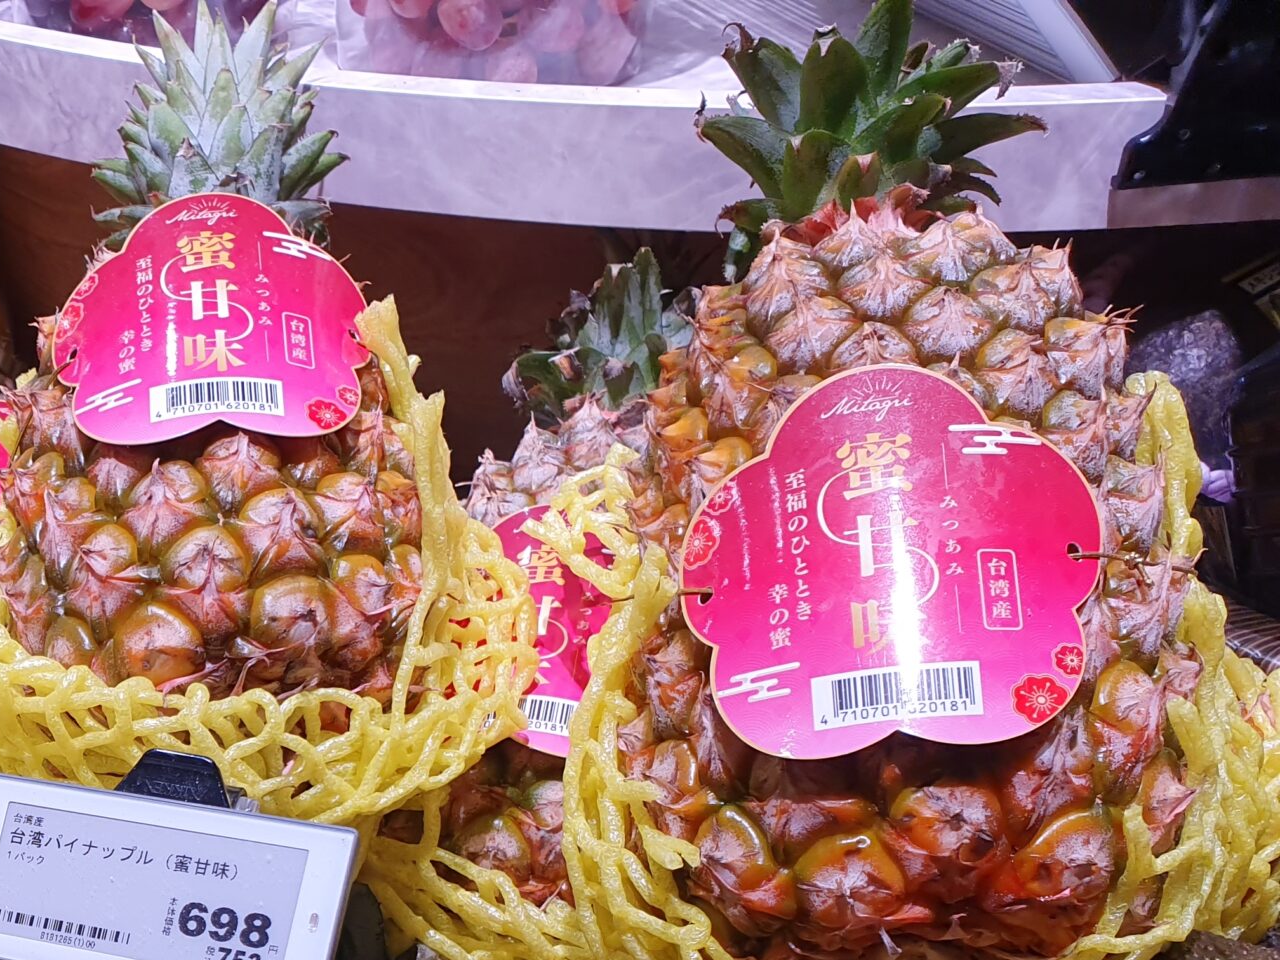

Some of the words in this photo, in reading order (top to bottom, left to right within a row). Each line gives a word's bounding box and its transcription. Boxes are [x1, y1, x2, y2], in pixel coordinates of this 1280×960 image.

[134, 255, 155, 352] 至福のひととき
[176, 230, 248, 374] 蜜甘味
[254, 273, 274, 327] みつあみ
[116, 328, 137, 375] 幸の蜜
[288, 318, 310, 363] 台湾産
[171, 402, 219, 415] 710701
[226, 401, 273, 412] 620181
[783, 468, 814, 622] 至福のひととき
[938, 494, 965, 577] みつあみ
[987, 556, 1013, 621] 台湾産
[767, 583, 793, 649] 幸の蜜
[524, 718, 565, 733] 20181
[820, 715, 828, 725] 4
[840, 705, 899, 722] 710701
[13, 813, 45, 827] 台湾産
[178, 902, 272, 949] 698
